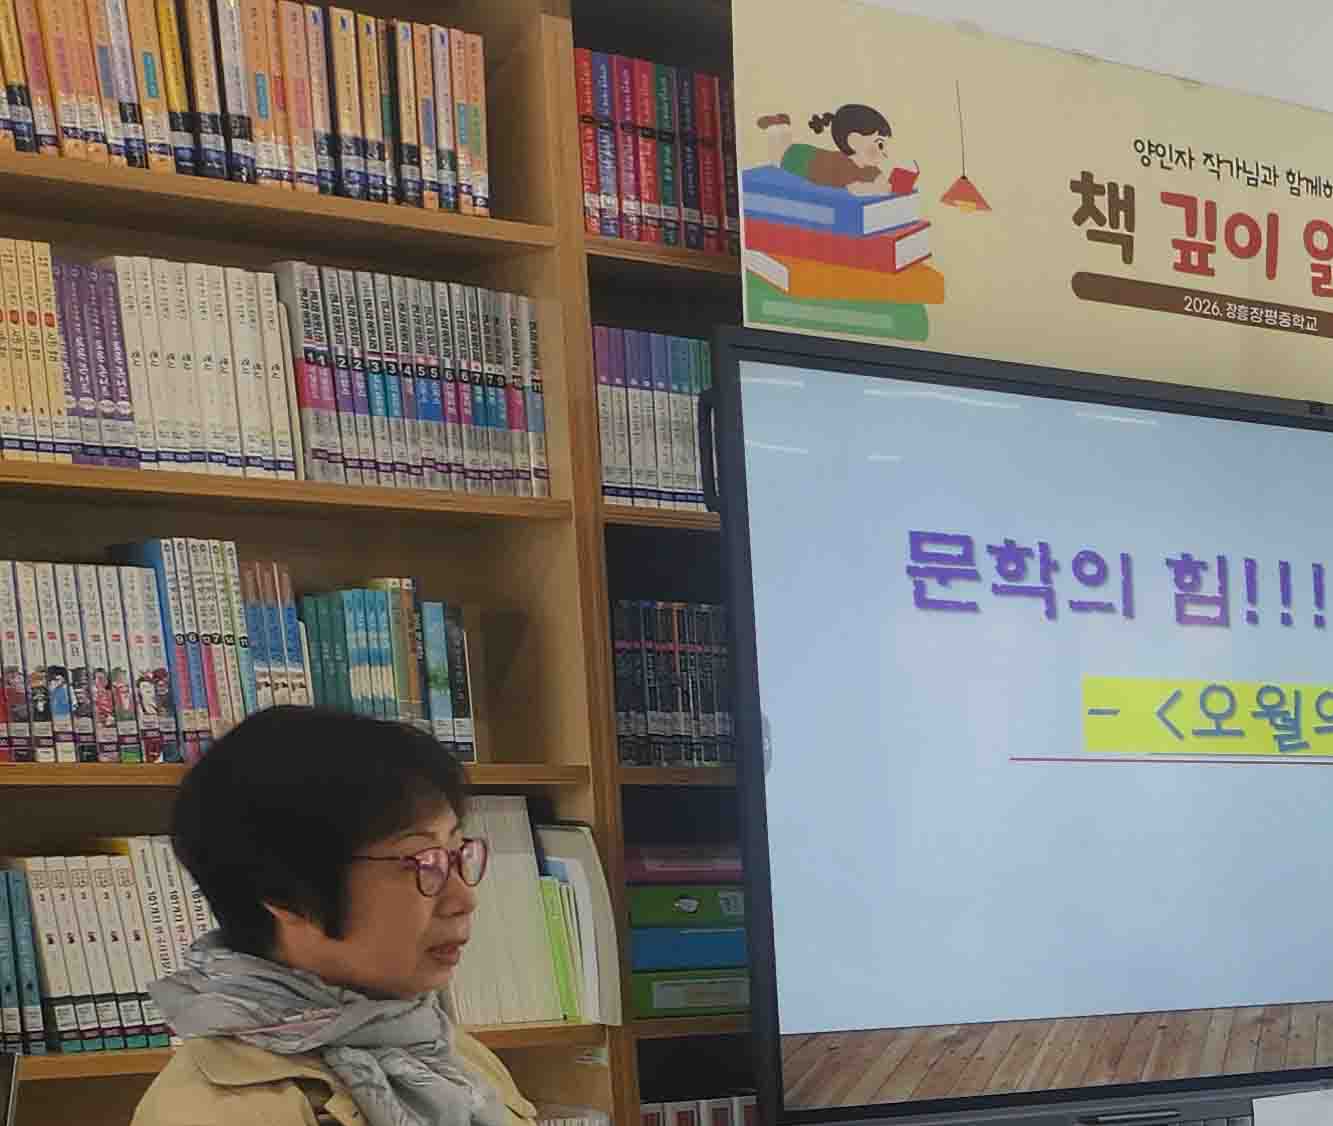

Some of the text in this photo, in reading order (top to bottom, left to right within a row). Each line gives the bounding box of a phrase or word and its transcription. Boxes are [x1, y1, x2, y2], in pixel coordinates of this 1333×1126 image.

[1133, 138, 1195, 170] 양인자
[1202, 152, 1280, 187] 작가님과
[1069, 170, 1136, 265] 책
[1160, 191, 1280, 281] 깊이
[1183, 295, 1223, 318] 2026.
[906, 530, 1328, 630] 문학의 힘!!!
